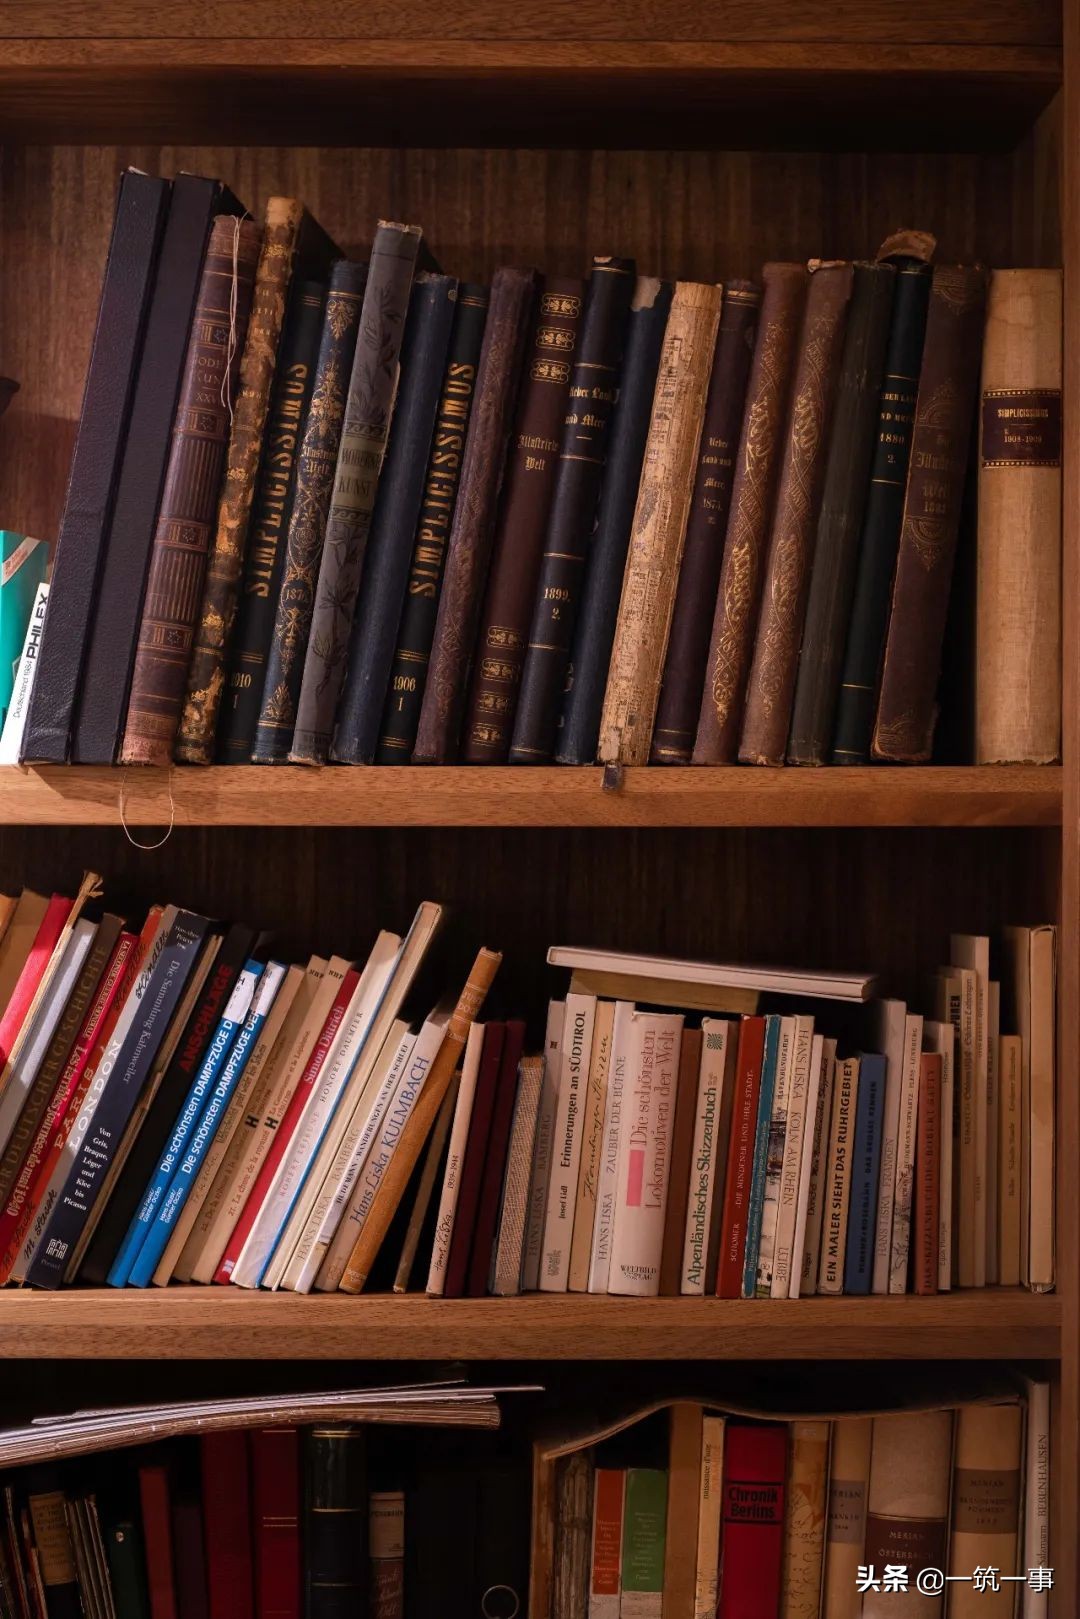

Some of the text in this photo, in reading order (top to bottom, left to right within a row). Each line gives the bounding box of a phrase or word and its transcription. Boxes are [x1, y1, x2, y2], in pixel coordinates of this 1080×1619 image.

[245, 359, 310, 598] SIMPLICISSIMUS
[408, 359, 477, 598] SIMPLICISSIMUS
[5, 942, 108, 1166] DEUTSCHER GESCHICHTE
[121, 959, 181, 1086] Die Sammlung Kahnweiler
[213, 1029, 252, 1098] DAMPFZÜGE
[301, 1002, 346, 1084] Simon Dittrich
[52, 1065, 95, 1149] PARIS
[68, 1039, 123, 1149] LONDON
[158, 1028, 230, 1173] Die schönsten DAMPFZÜGE
[188, 1095, 223, 1155] schönsten
[559, 1009, 586, 1168] Erinnerungen an SÜDTIROL
[609, 1099, 622, 1124] DER
[628, 1028, 658, 1146] Die schönsten
[643, 1029, 675, 1209] Lokomotiven der Welt
[741, 1098, 751, 1120] IHRE
[781, 1028, 809, 1206] HANS LISKA AM RHEIN
[99, 1127, 111, 1138] Von
[180, 1153, 197, 1174] Die
[347, 1054, 430, 1226] Hans Liska KULMBACH
[604, 1126, 619, 1174] ZAUBER
[695, 1086, 716, 1172] Skizzenbuch
[739, 1122, 749, 1142] UND
[880, 1137, 894, 1187] FRANKEN
[63, 1197, 87, 1210] Picasso
[75, 1178, 92, 1189] Klee
[295, 1226, 317, 1261] HANS
[329, 1125, 361, 1182] BAMBERG
[600, 1191, 613, 1225] LISKA
[825, 1062, 853, 1282] EIN MALER SIEHT DAS RUHRGEBIET
[596, 1227, 610, 1261] HANS
[686, 1172, 711, 1286] Alpenländisches
[876, 1228, 888, 1256] HANS
[729, 1487, 778, 1504] Chronik
[731, 1503, 774, 1519] Berlins
[1036, 1433, 1048, 1516] BEBENHAUSEN
